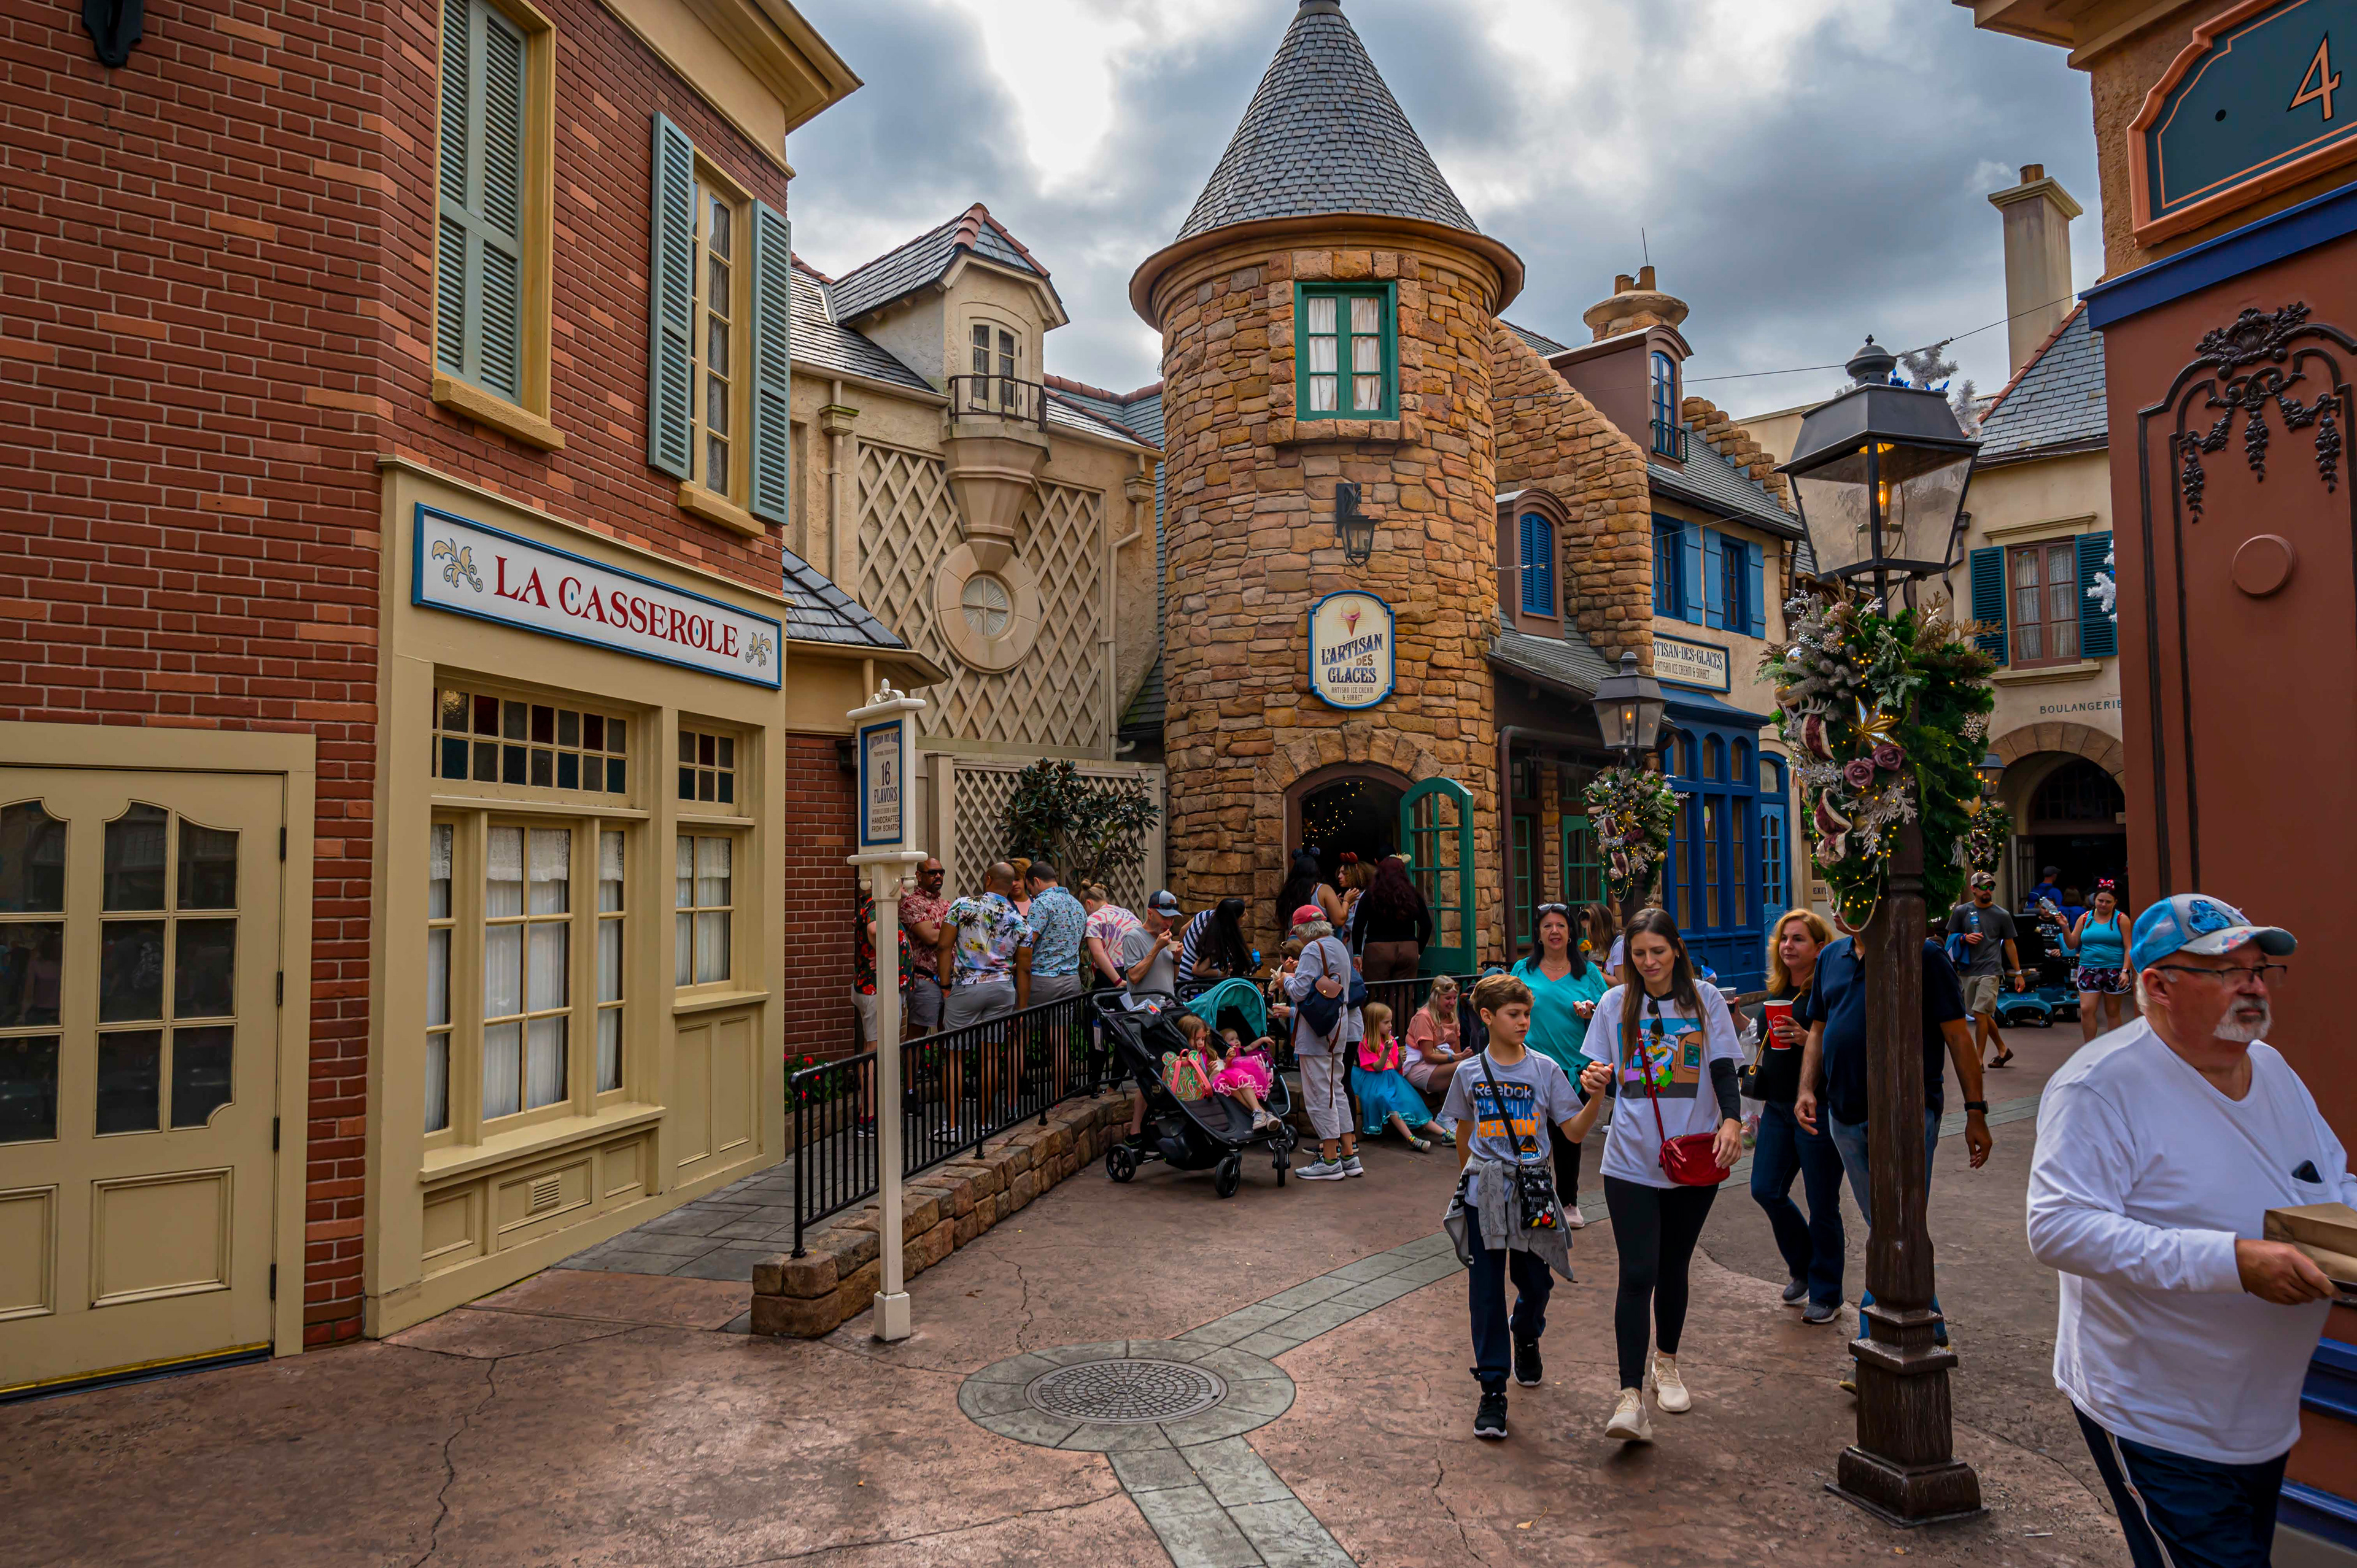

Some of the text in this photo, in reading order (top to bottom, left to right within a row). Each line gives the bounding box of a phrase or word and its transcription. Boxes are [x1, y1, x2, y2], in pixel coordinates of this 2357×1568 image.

[2286, 29, 2342, 123] 4
[493, 555, 739, 658] LA CASSEROLE
[1321, 633, 1384, 665] L'ARTISAN
[1356, 654, 1373, 666] DES
[1681, 646, 1694, 662] DES
[1697, 649, 1722, 670] GLACES
[1328, 666, 1377, 683] GLACES
[881, 760, 891, 786] 16
[874, 786, 898, 804] FLAVORS
[1475, 1083, 1532, 1099] Reebok
